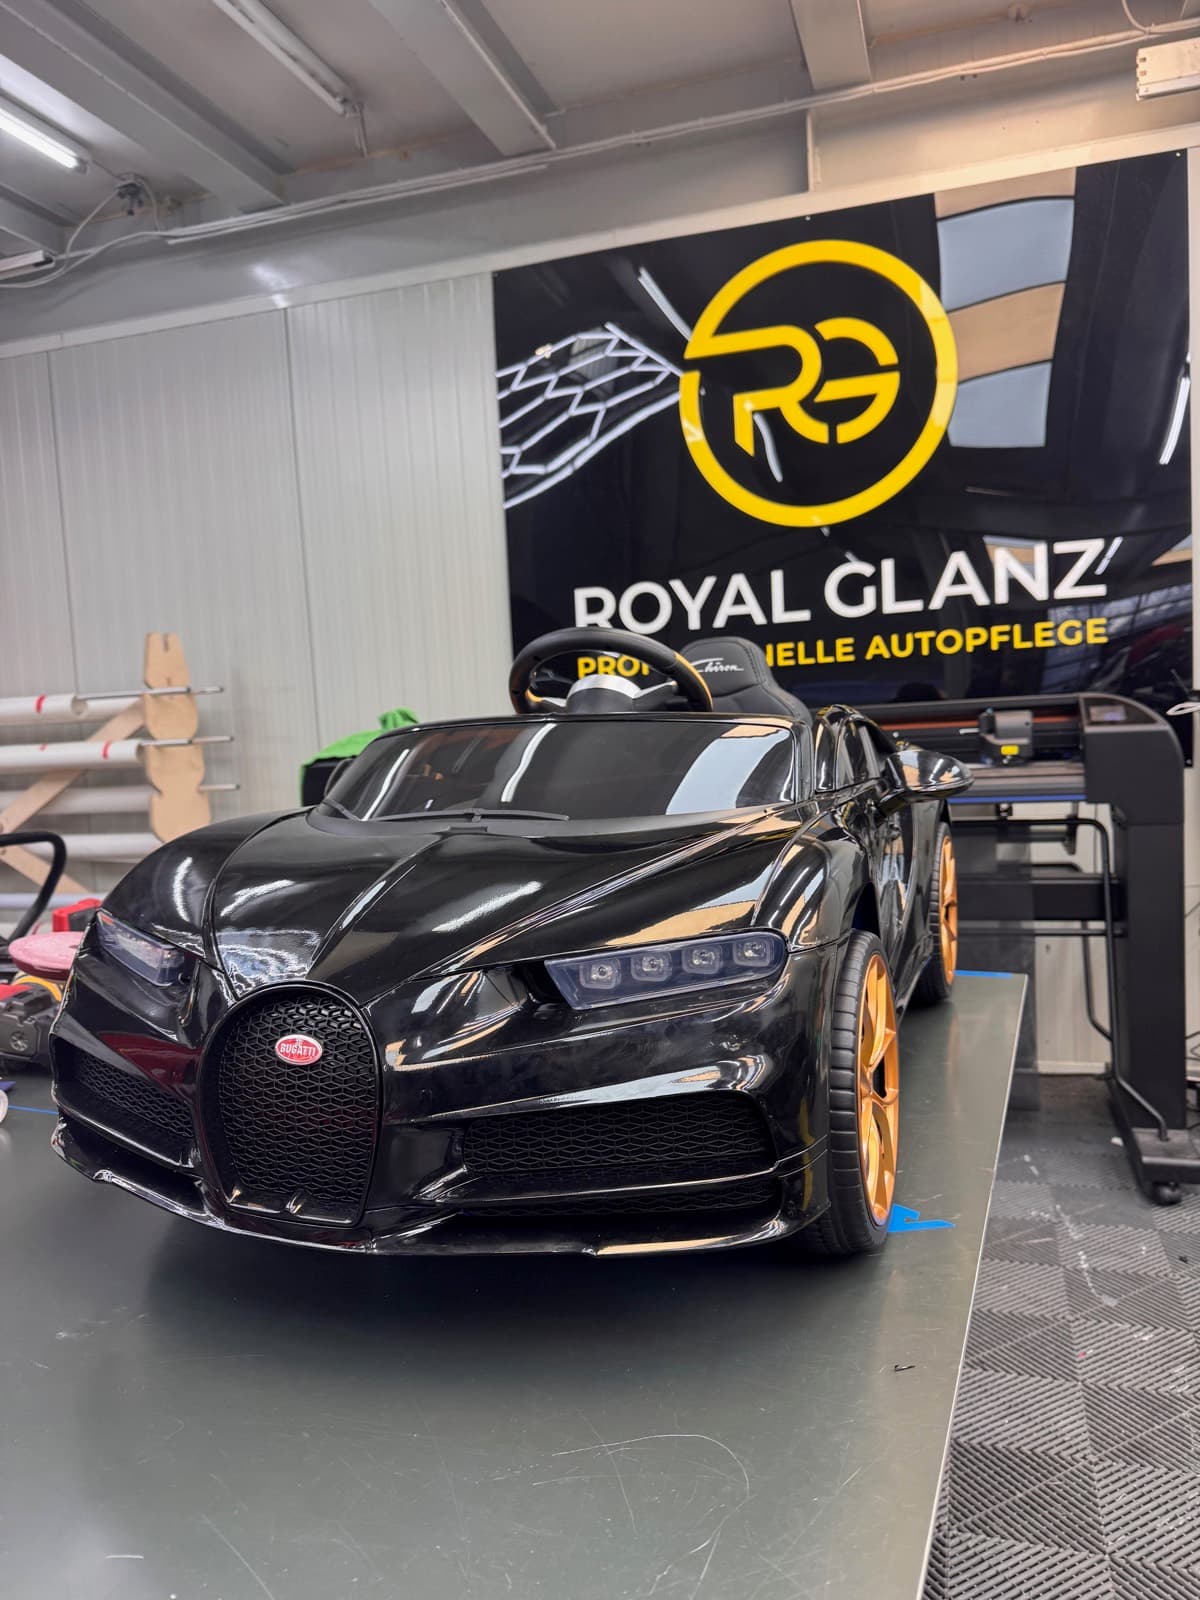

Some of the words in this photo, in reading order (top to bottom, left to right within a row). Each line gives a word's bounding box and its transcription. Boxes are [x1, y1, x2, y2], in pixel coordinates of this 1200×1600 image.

[684, 317, 900, 457] RG
[573, 569, 811, 635] ROYAL
[824, 538, 1107, 618] GLANZ
[865, 617, 1109, 661] AUTOPFLEGE
[280, 1043, 317, 1057] BUGATTI
